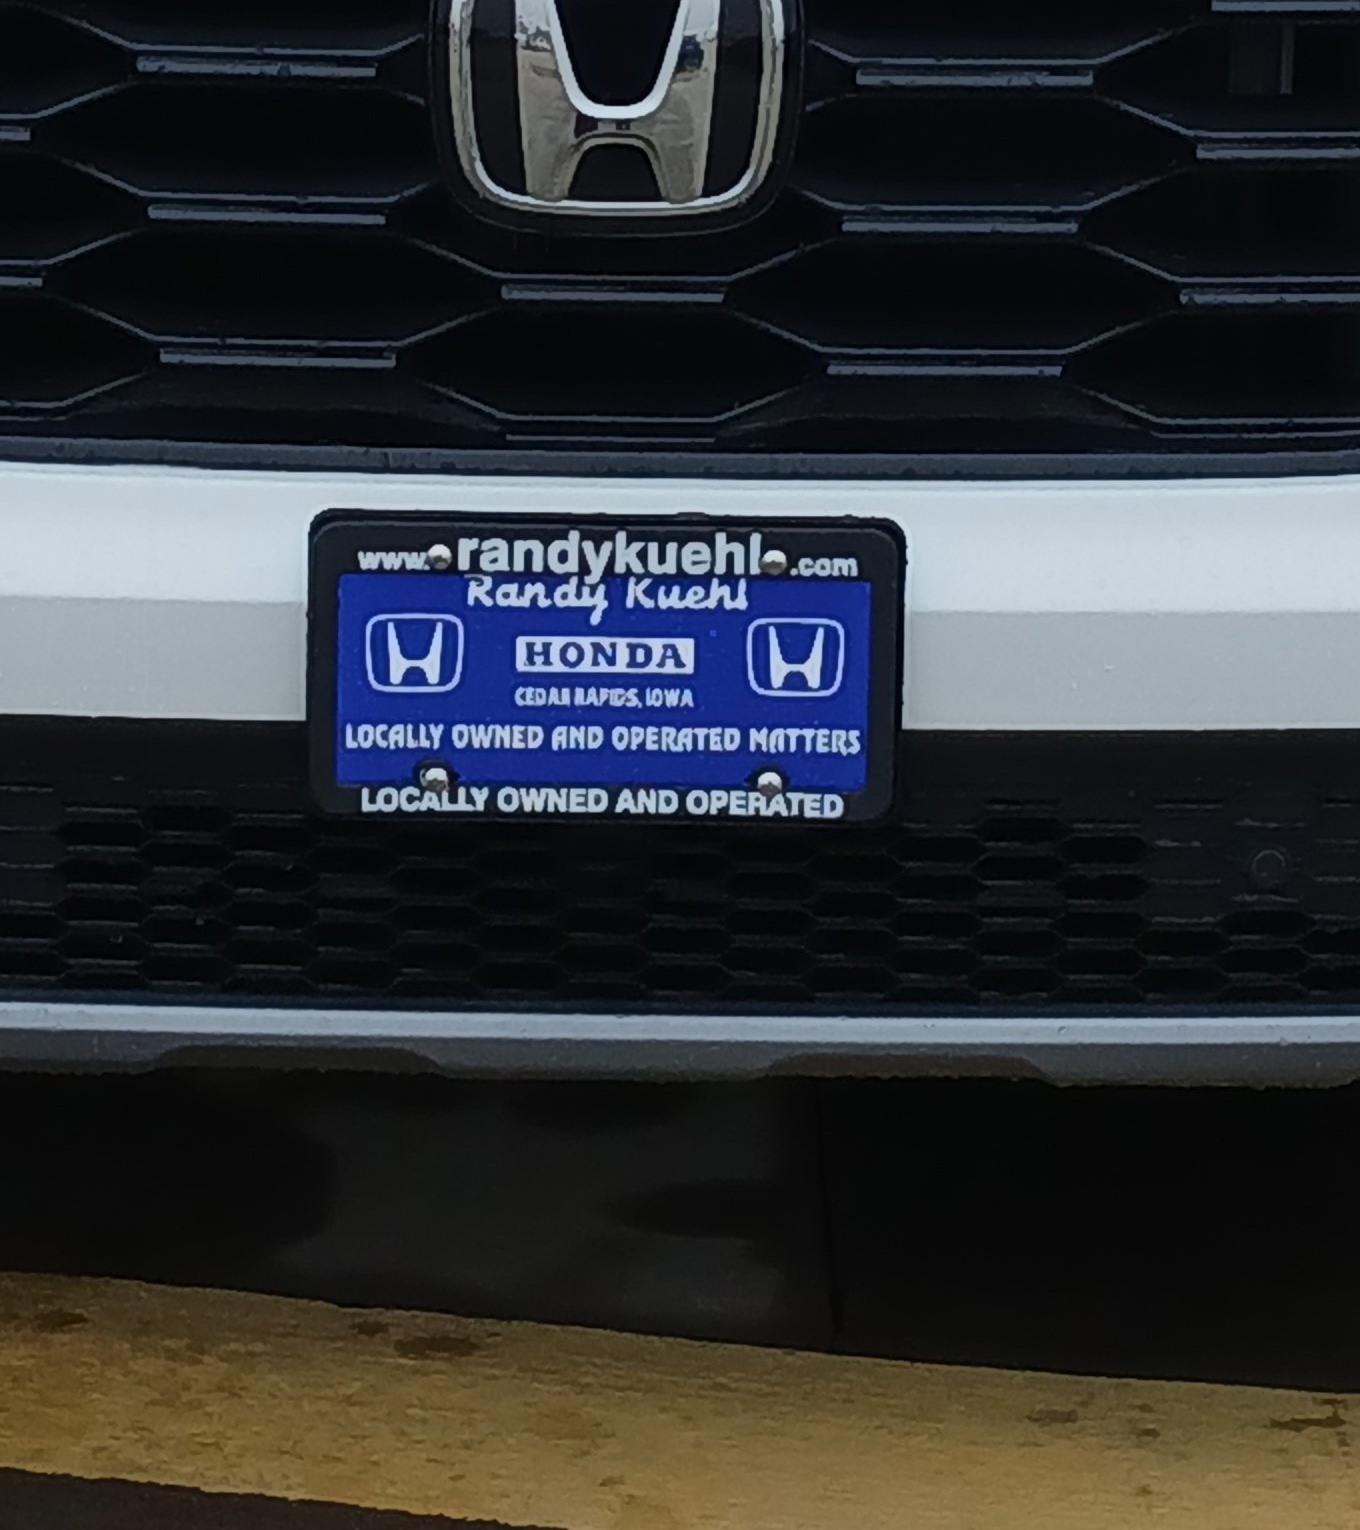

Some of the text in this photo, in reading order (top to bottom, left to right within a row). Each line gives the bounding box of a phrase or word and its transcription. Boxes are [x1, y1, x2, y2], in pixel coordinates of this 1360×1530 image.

[464, 574, 748, 626] Randy Kuehl
[524, 641, 687, 669] HONDA
[646, 687, 694, 708] IOWA
[345, 722, 861, 756] LOCALLY OWNED AND OPERATED MATTERS
[361, 786, 844, 819] LOCALLY OWNED AND OPERATED
